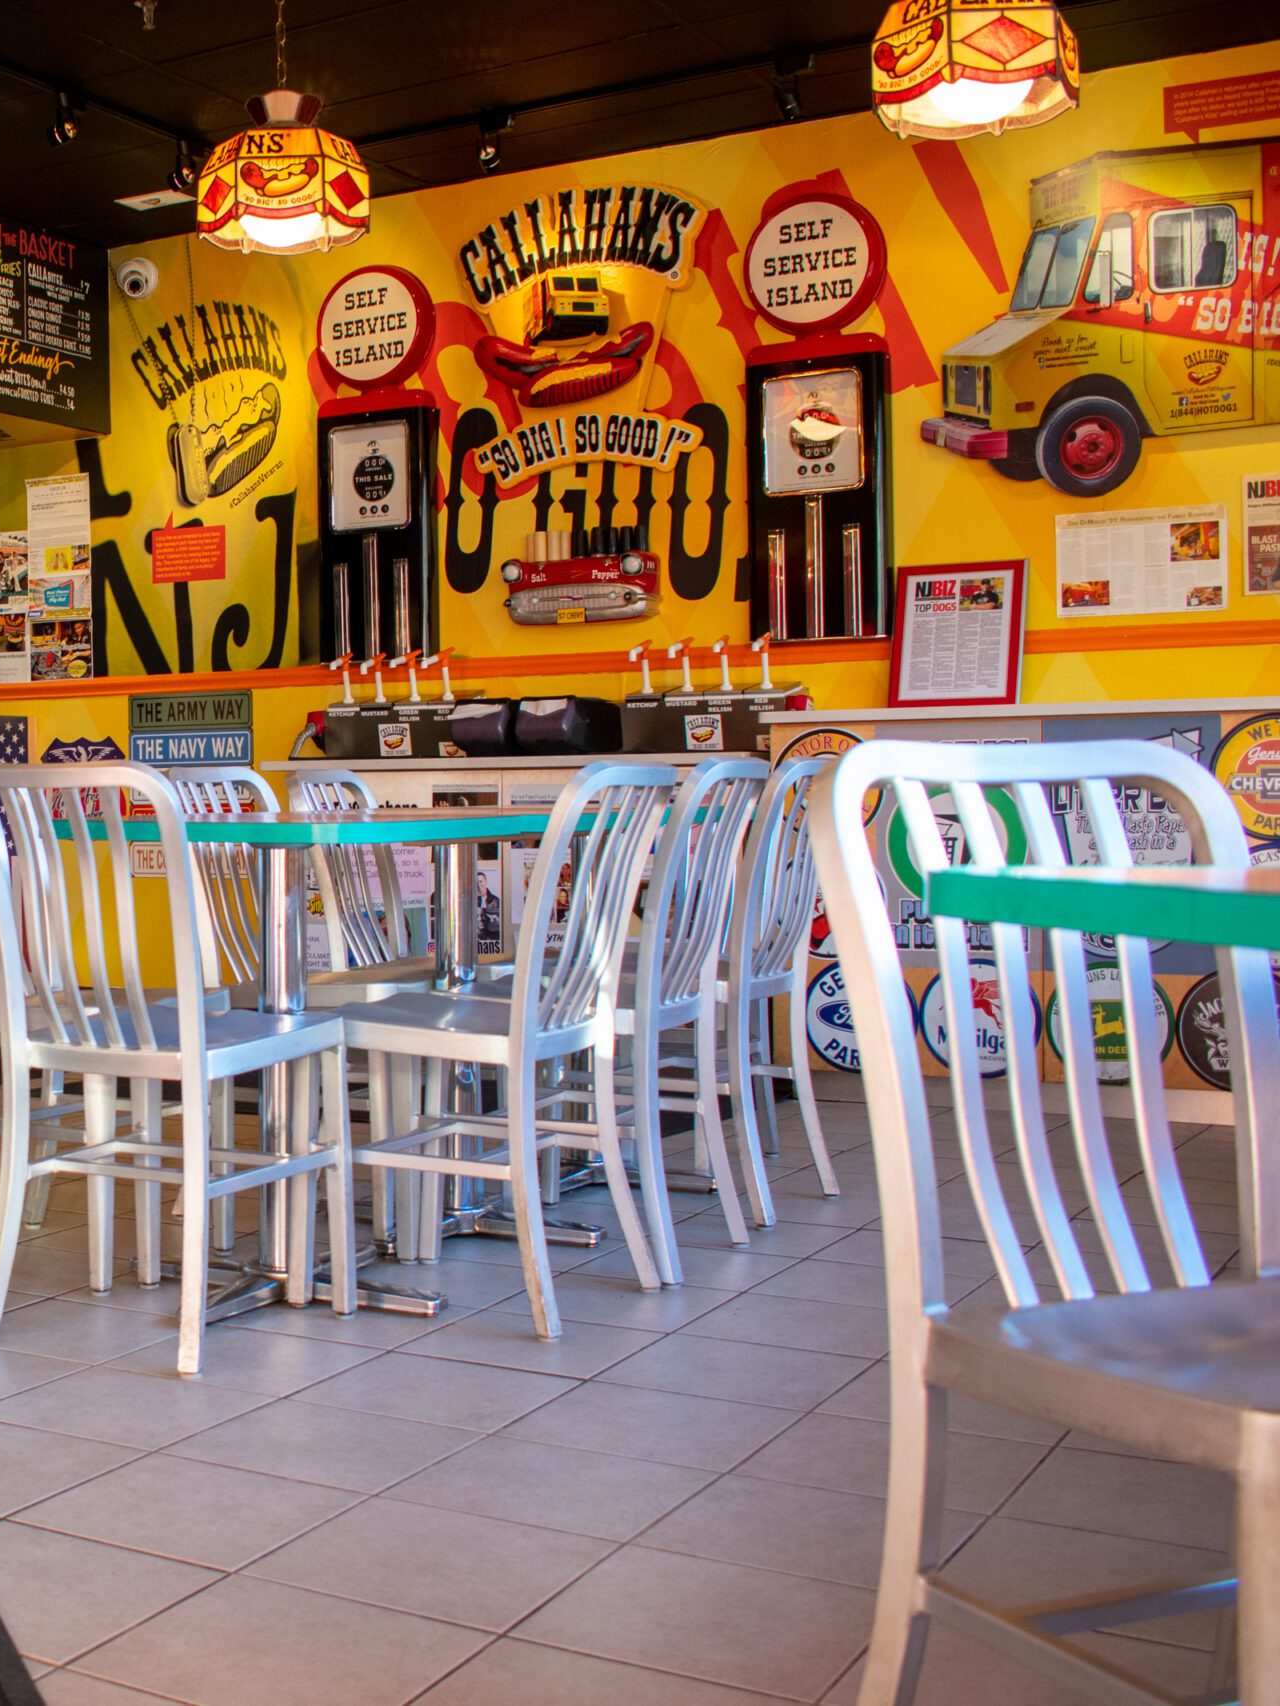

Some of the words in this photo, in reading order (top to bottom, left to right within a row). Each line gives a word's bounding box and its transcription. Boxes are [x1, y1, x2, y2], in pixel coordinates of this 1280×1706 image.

[779, 218, 833, 245] SELF
[2, 232, 17, 247] THE
[19, 228, 76, 269] BASKET
[459, 186, 697, 305] CALLAHAN'S
[763, 247, 857, 277] SERVICE
[344, 287, 388, 311] SELF
[766, 278, 853, 307] ISLAND
[332, 312, 407, 340] SERVICE
[8, 340, 75, 380] Endings
[130, 300, 288, 411] CALLAHAN'S
[335, 340, 405, 368] ISLAND
[1183, 349, 1229, 369] CALLAHAN'S
[1170, 403, 1238, 419] 1(844)HOTDOG1
[575, 414, 600, 454] SO
[229, 459, 285, 510] #CallahansVeteran
[355, 475, 372, 483] THIS
[373, 473, 393, 482] SALE
[1251, 534, 1278, 545] BLAST
[530, 572, 547, 583] Salt
[591, 569, 620, 583] Pepper
[915, 579, 956, 598] NJBIZ
[558, 611, 568, 620] 57
[569, 610, 584, 620] CHEVY
[914, 603, 931, 613] TOP
[932, 602, 957, 613] DOGS
[136, 702, 163, 724] THE
[166, 701, 208, 723] ARMY
[211, 698, 244, 720] WAY
[136, 740, 164, 762] THE
[168, 738, 212, 760] NAVY
[214, 736, 244, 759] WAY
